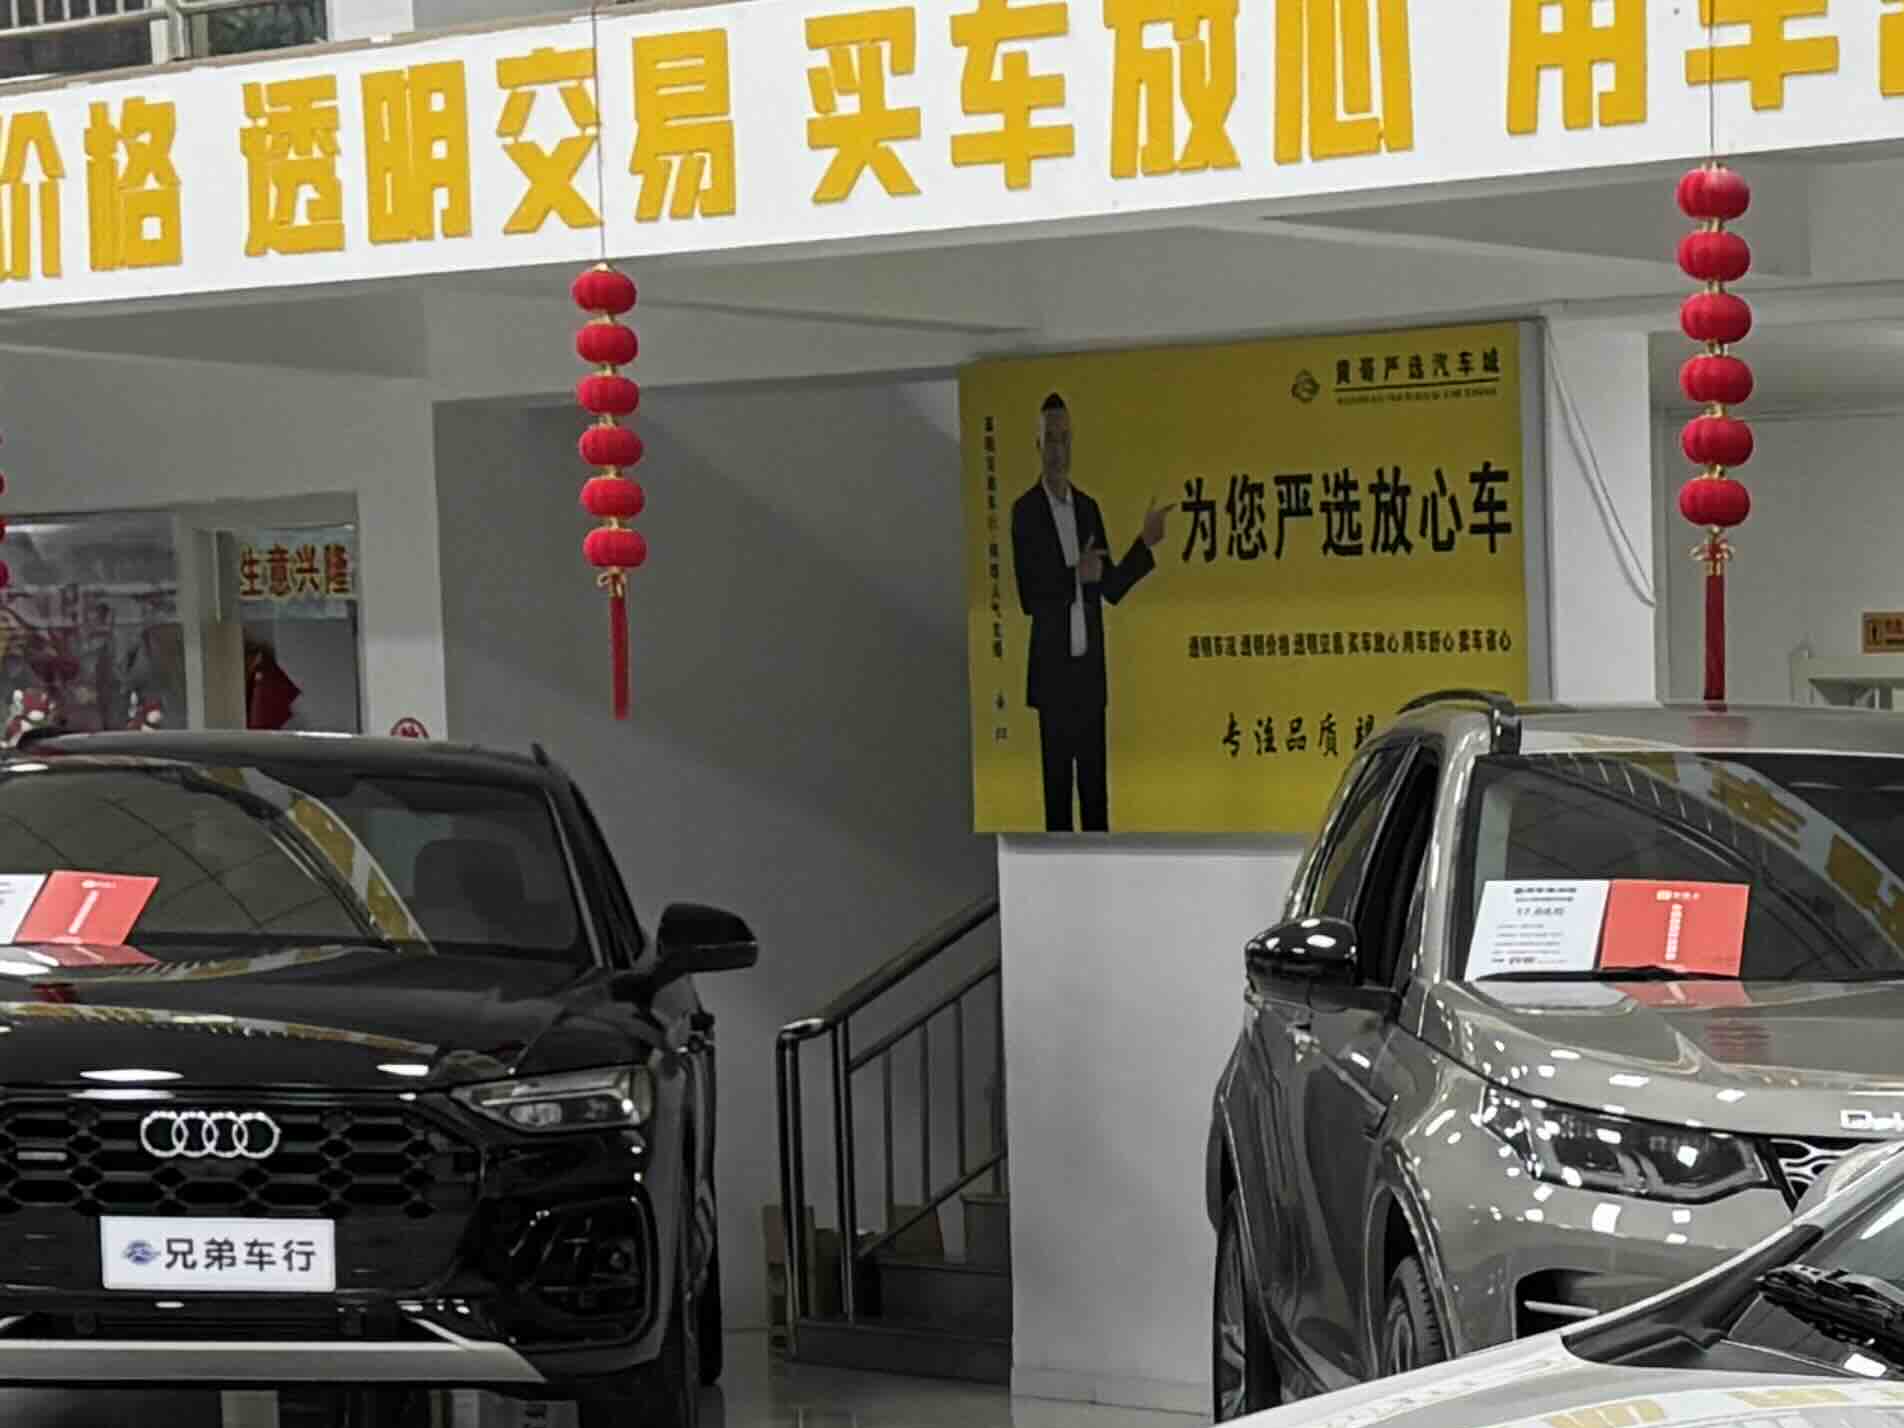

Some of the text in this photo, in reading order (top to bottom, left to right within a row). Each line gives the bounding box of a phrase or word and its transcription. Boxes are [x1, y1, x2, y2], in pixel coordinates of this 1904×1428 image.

[240, 31, 735, 256] 透明交易
[807, 0, 1413, 202] 买车放心
[1181, 461, 1513, 564] 为您严选放心车
[240, 543, 350, 596] 生意兴隆
[164, 1237, 316, 1272] 兄弟车行
